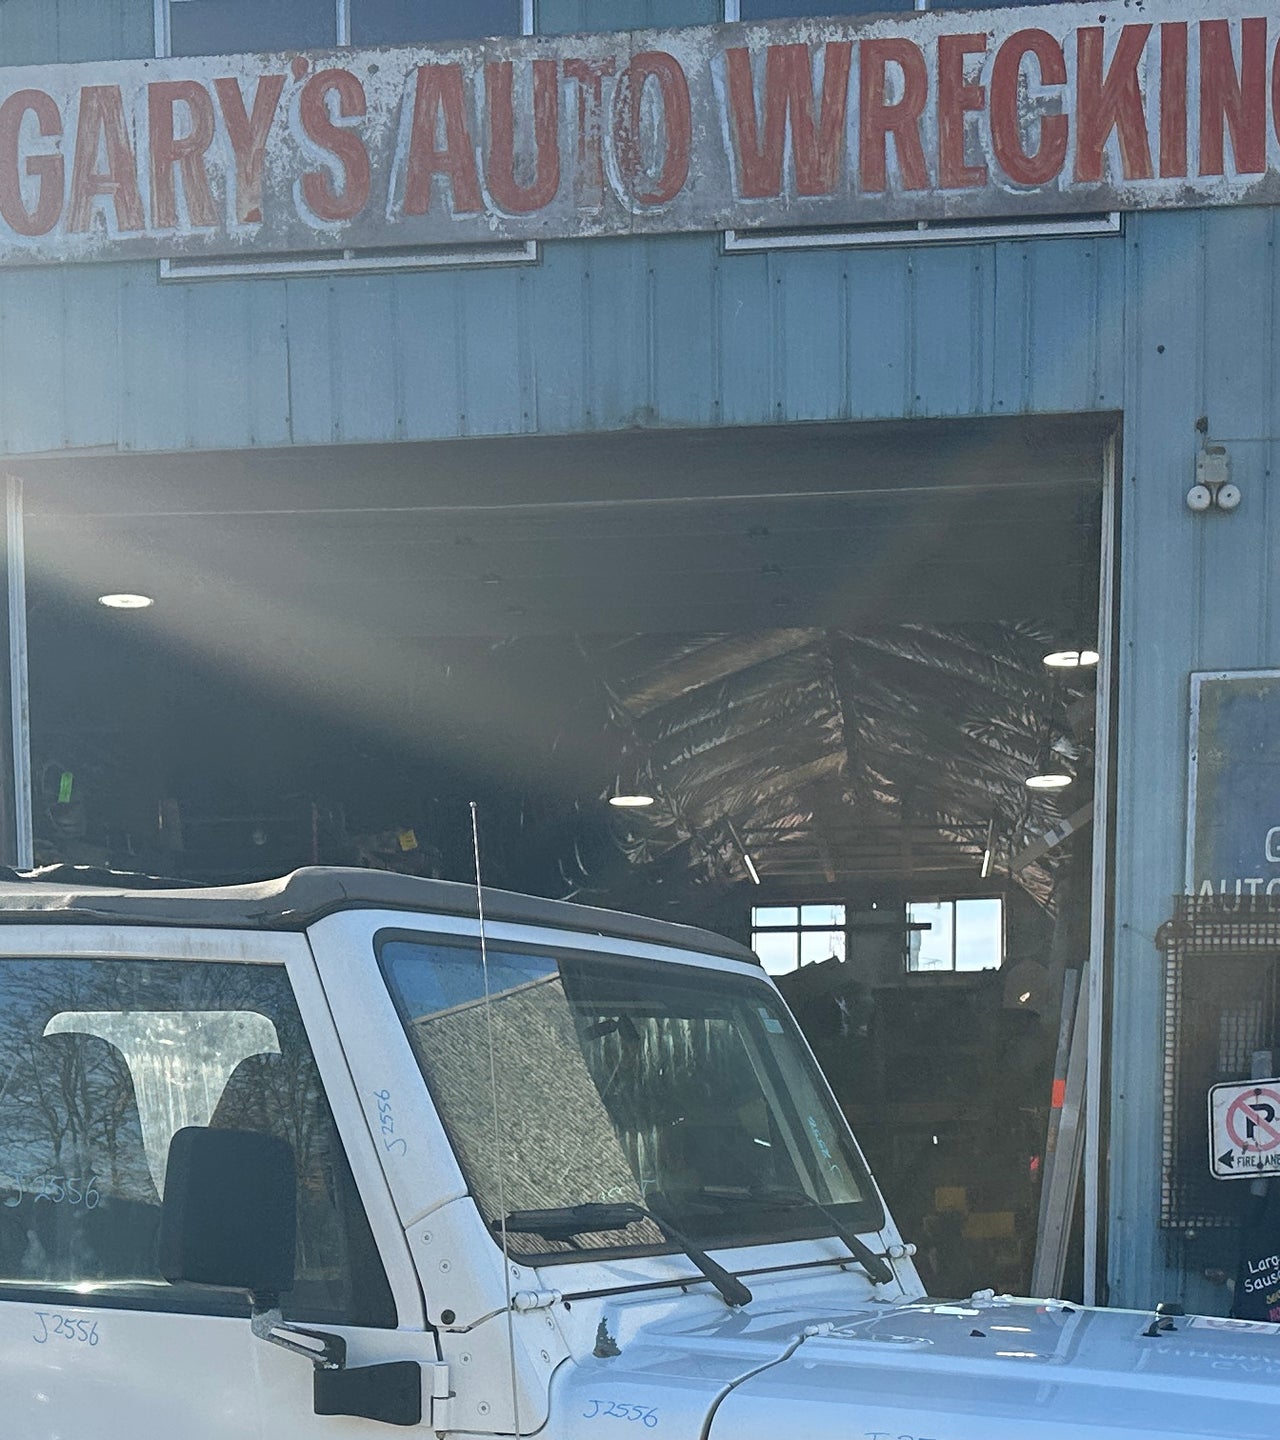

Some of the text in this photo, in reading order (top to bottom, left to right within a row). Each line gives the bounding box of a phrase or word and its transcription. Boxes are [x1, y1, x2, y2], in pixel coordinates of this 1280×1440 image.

[404, 50, 691, 218] AUTO
[373, 1089, 407, 1157] J2556
[1236, 1155, 1257, 1168] FIRE
[3, 1171, 100, 1209] J2556
[33, 1311, 99, 1346] J2556
[583, 1399, 659, 1428] J2556
